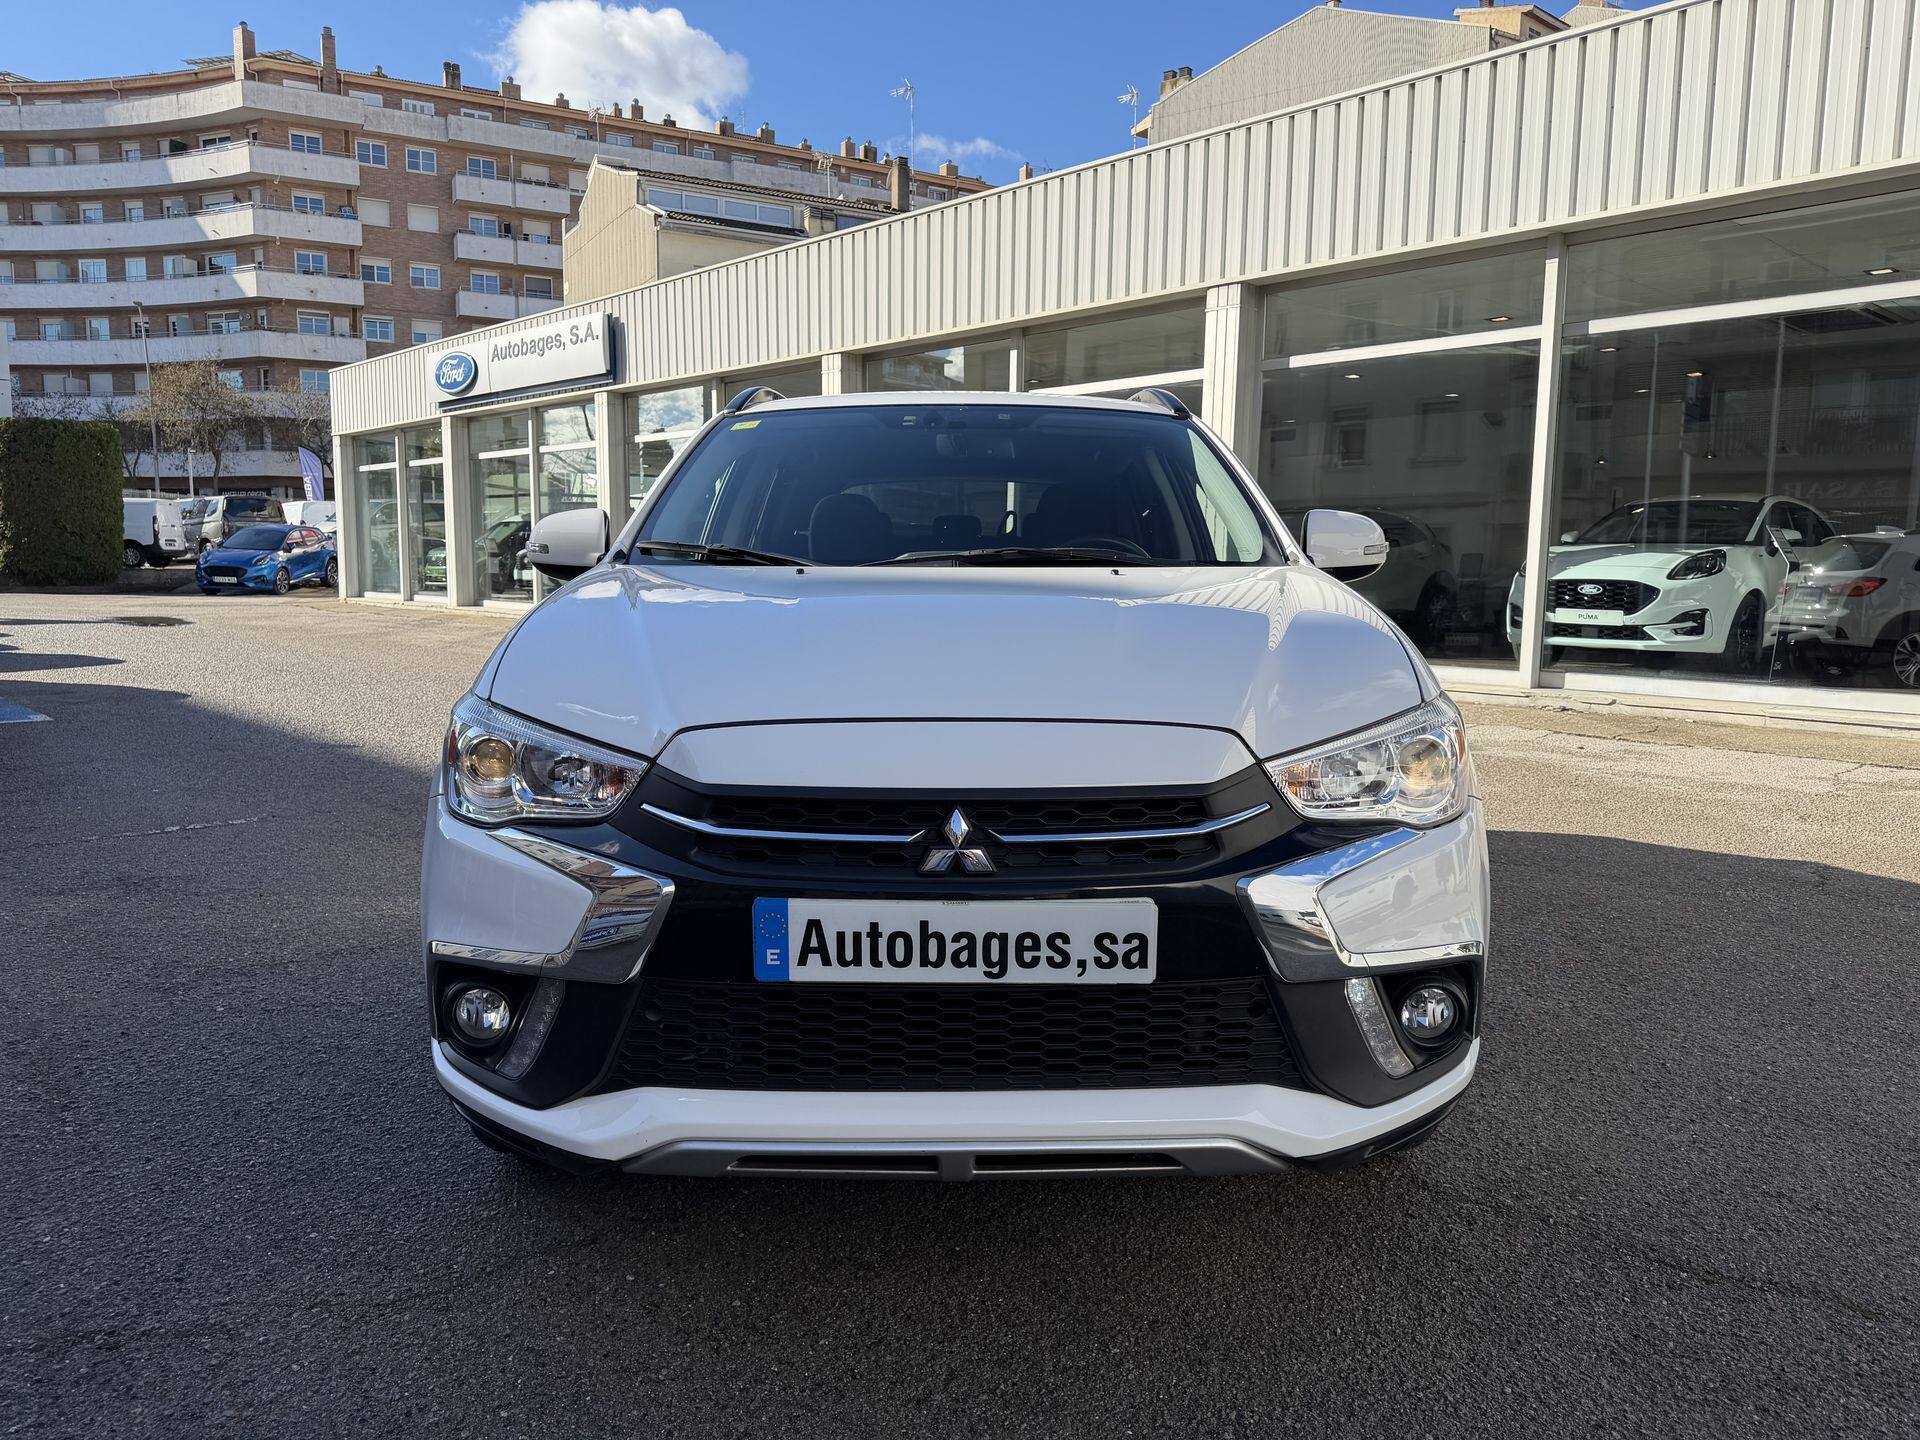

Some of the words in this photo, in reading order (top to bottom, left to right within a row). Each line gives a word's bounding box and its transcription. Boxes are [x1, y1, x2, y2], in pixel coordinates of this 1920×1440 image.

[491, 333, 566, 362] Autobages,
[570, 322, 599, 346] S.A.
[440, 358, 465, 385] Ford
[1578, 612, 1599, 621] PUMA
[766, 948, 780, 965] E
[796, 918, 1150, 979] Autobages,sa
